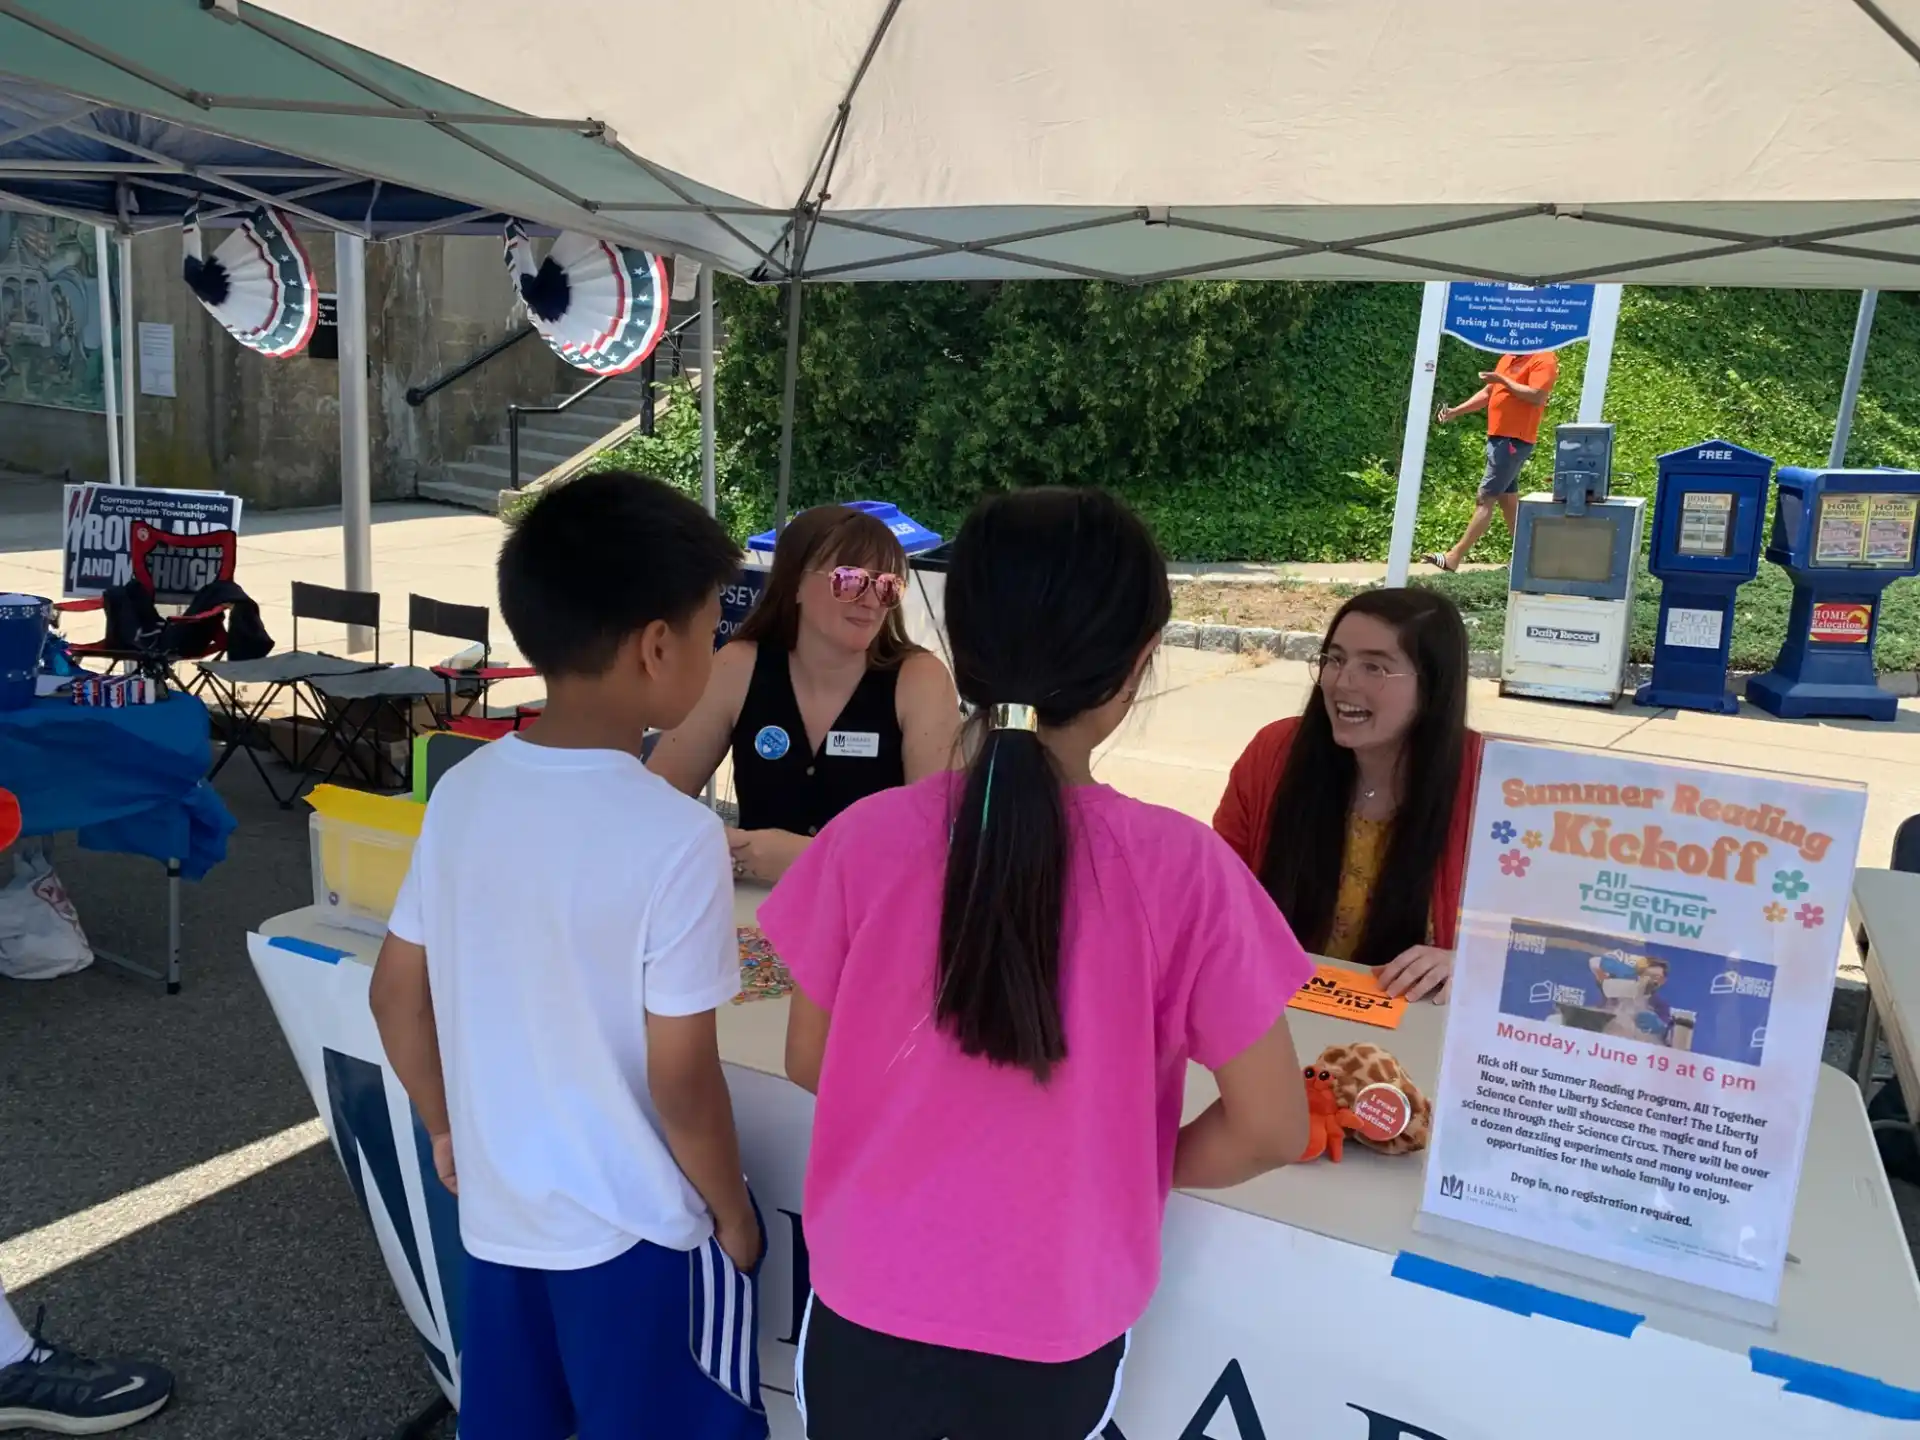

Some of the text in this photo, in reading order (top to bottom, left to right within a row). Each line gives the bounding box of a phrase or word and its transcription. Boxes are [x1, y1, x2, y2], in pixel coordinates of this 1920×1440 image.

[1456, 316, 1578, 332] Parking In Designated Spaces
[1509, 329, 1518, 337] &
[1522, 336, 1544, 346] Only
[1698, 450, 1733, 460] FREE
[100, 495, 229, 513] Common Sense Leadership
[100, 504, 207, 519] for Chatham Township
[1827, 503, 1864, 511] HOME
[81, 557, 113, 577] AND
[1811, 620, 1864, 629] Relocation
[1813, 610, 1848, 620] HOME
[1530, 628, 1597, 641] Daily Record
[1673, 633, 1717, 647] GUIDE
[1501, 778, 1834, 863] Summer Reading
[1548, 810, 1769, 886] Kickoff
[1596, 870, 1628, 889] All
[1578, 883, 1717, 921] Together
[1628, 910, 1705, 939] Now
[1496, 1022, 1756, 1092] Monday, June 19 at 6 pm
[1477, 1054, 1500, 1068] Kick
[1502, 1060, 1518, 1072] off
[1520, 1066, 1539, 1077] our
[1541, 1068, 1587, 1087] Summer
[1589, 1078, 1635, 1101] Reading
[1693, 1102, 1709, 1115] All
[1713, 1106, 1768, 1128] Together
[1376, 1099, 1399, 1114] read
[1511, 1079, 1536, 1093] with
[1538, 1085, 1557, 1097] the
[1559, 1088, 1599, 1108] Liberty
[1601, 1097, 1643, 1117] Science
[1646, 1108, 1688, 1127] Center!
[1691, 1117, 1713, 1133] The
[1716, 1124, 1759, 1145] Liberty
[1382, 1112, 1397, 1125] my
[1476, 1086, 1758, 1160] Science Center will showcase the magic and fun of
[1461, 1099, 1771, 1179] science through their Science Circus. There will be over
[1471, 1117, 1754, 1192] a dozen dazzling experiments and many volunteer
[1486, 1136, 1731, 1205] opportunities for the whole family to enjoy.
[1466, 1183, 1519, 1204] LIBRARY
[1511, 1171, 1537, 1189] Drop
[1555, 1184, 1570, 1195] no
[1571, 1187, 1638, 1213] registration
[1640, 1205, 1693, 1228] required.
